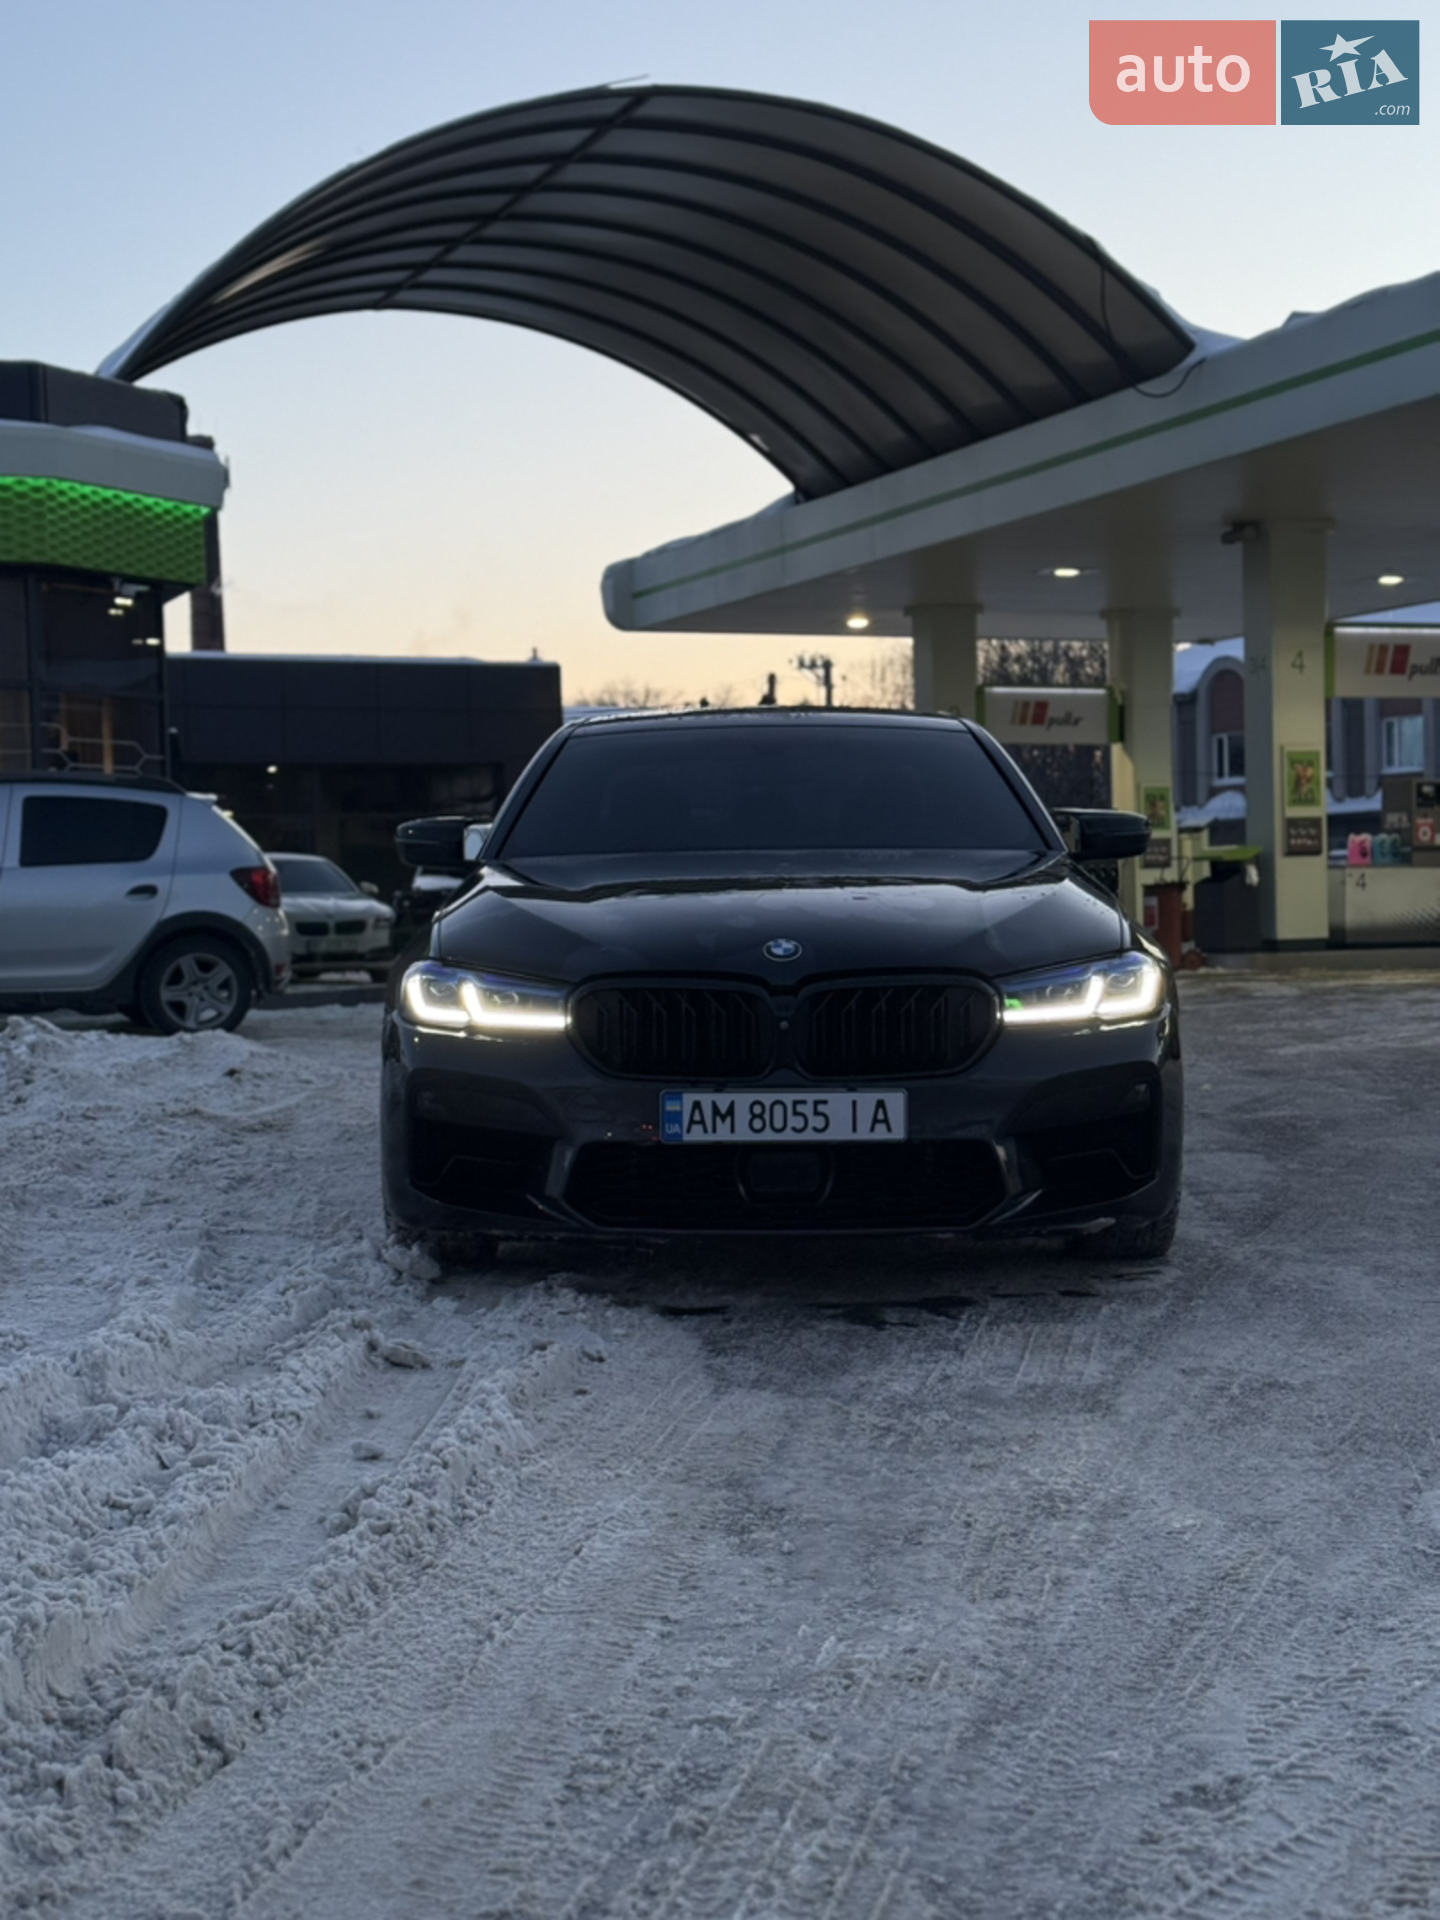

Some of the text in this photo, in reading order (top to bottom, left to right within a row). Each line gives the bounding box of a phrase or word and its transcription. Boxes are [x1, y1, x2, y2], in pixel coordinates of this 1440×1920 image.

[1290, 650, 1306, 674] 4
[1355, 872, 1367, 891] 4
[686, 1100, 735, 1134] AM
[748, 1100, 830, 1134] 8055
[665, 1123, 681, 1134] UA
